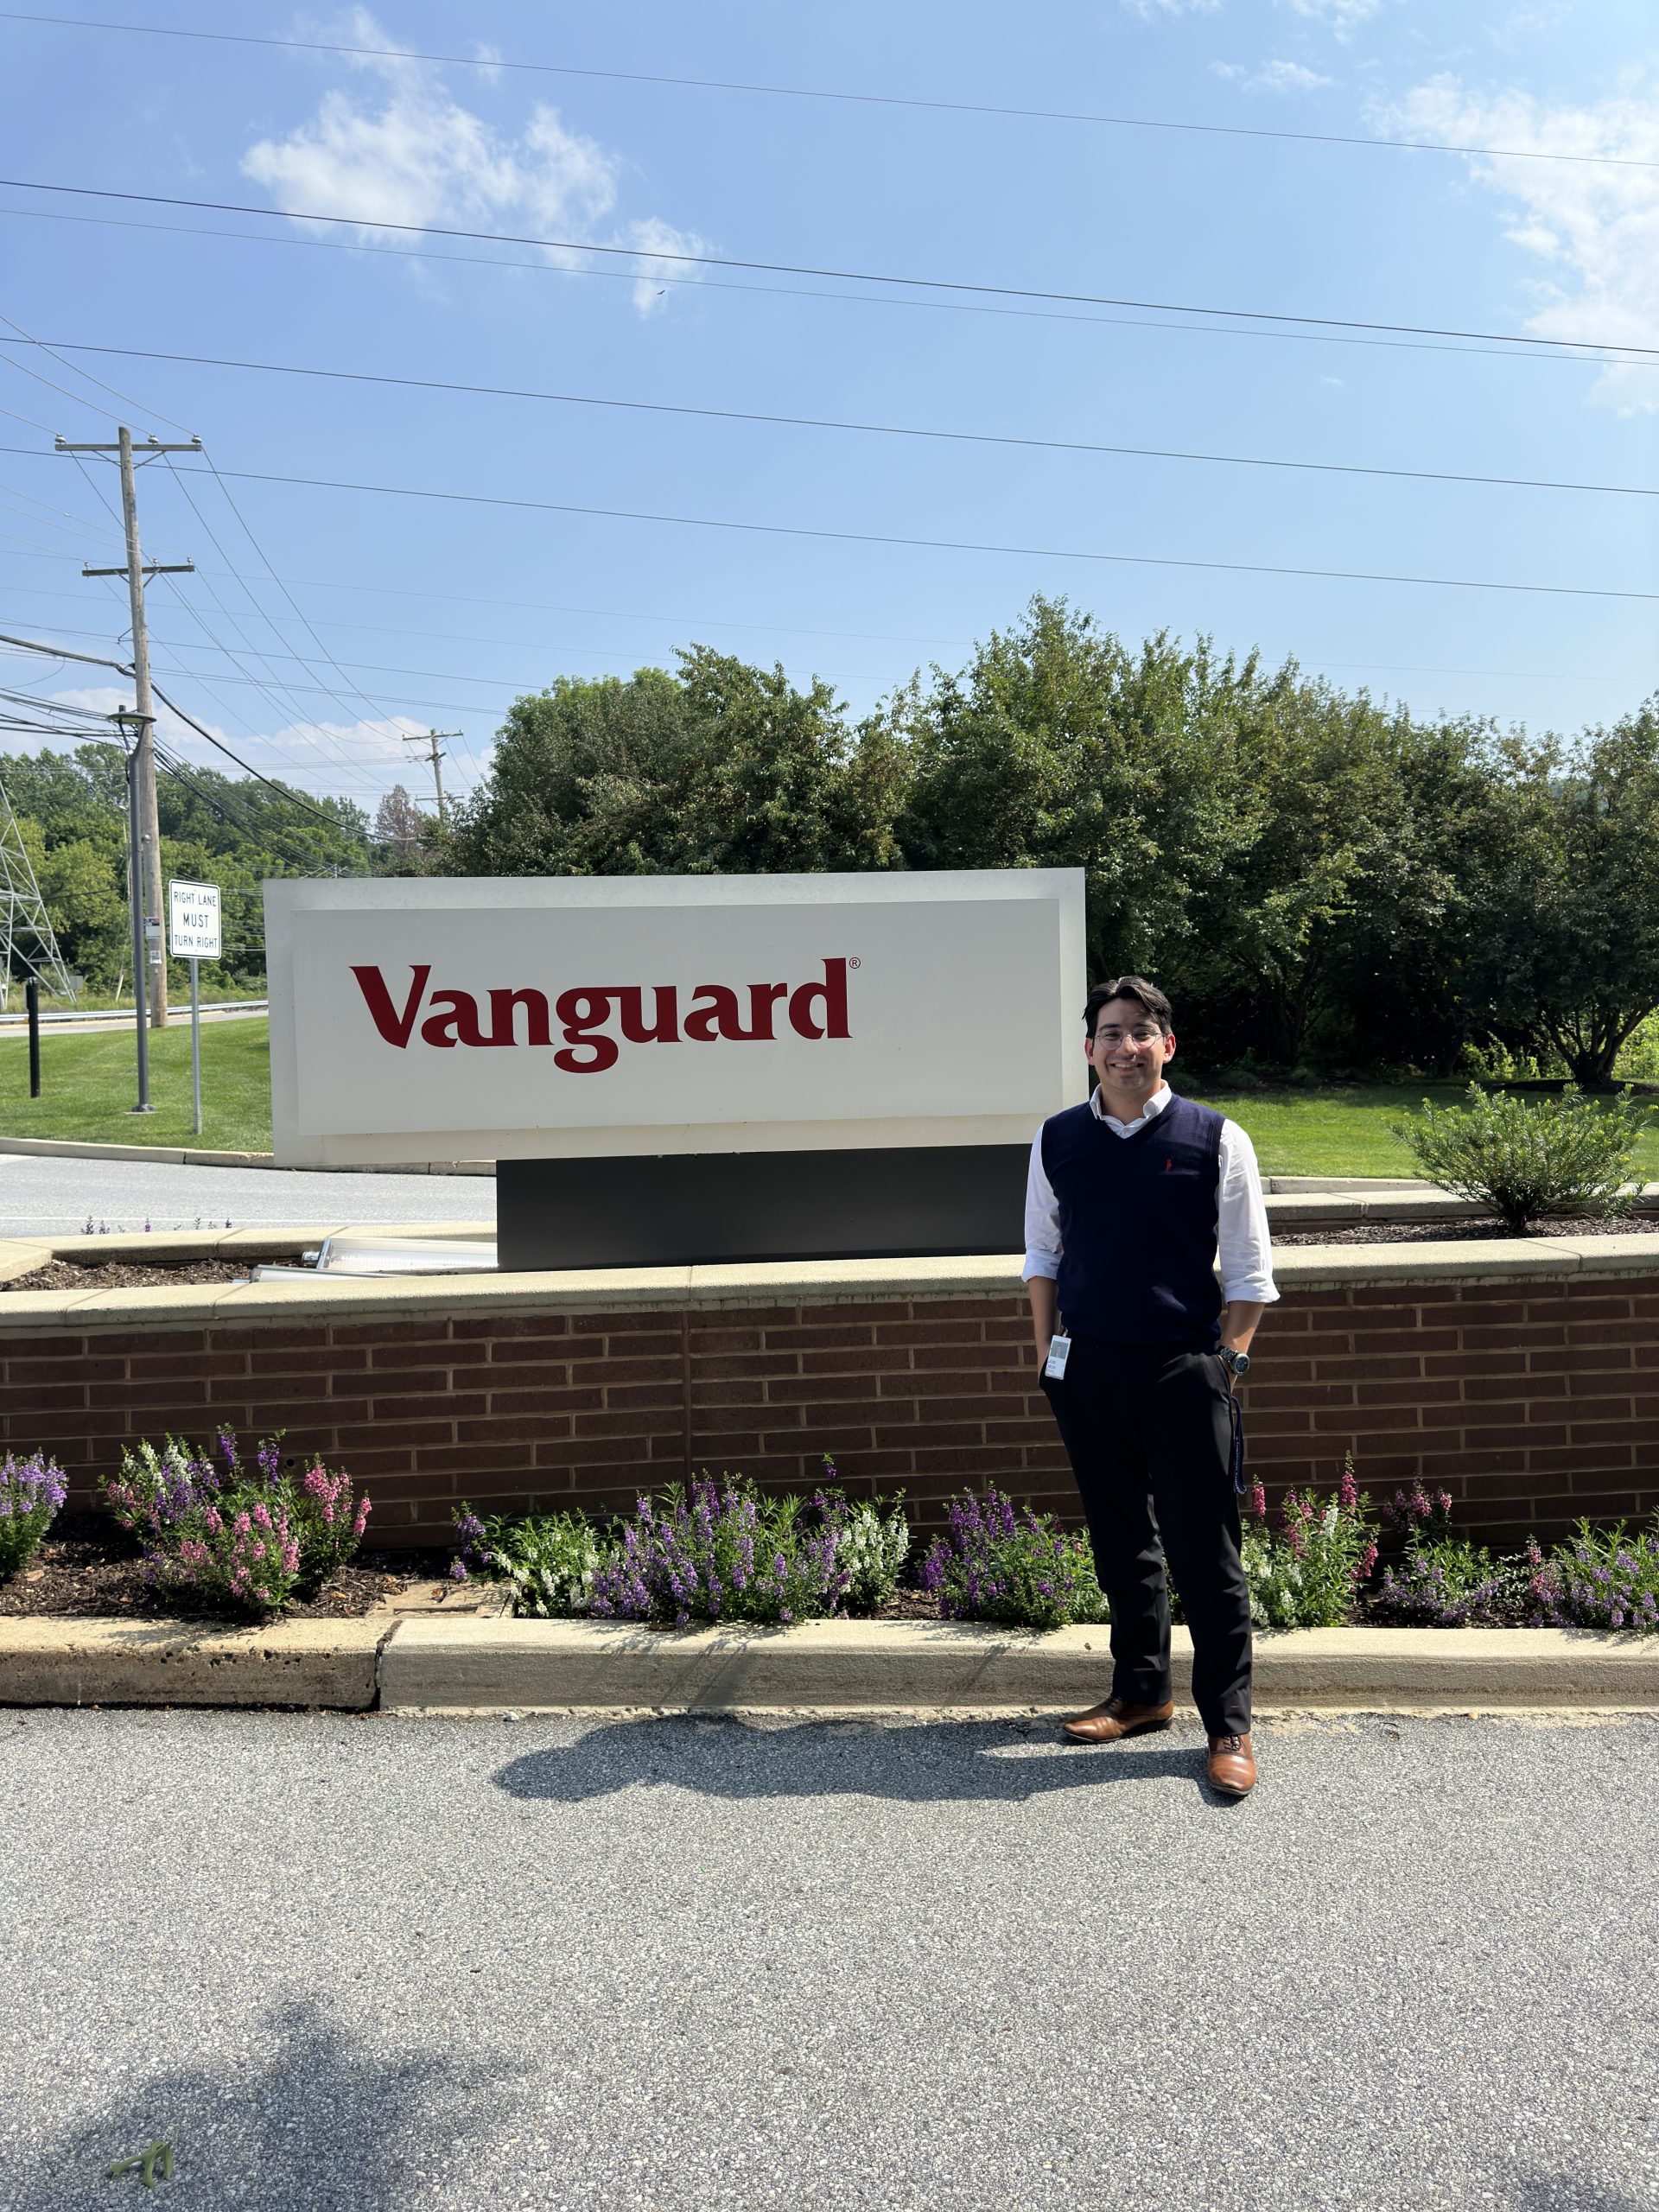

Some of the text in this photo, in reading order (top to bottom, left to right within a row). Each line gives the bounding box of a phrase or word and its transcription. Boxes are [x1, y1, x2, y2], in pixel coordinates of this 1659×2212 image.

[174, 891, 217, 906] RIGHT LANE
[182, 912, 209, 928] MUST
[174, 934, 218, 949] TURN RIGHT
